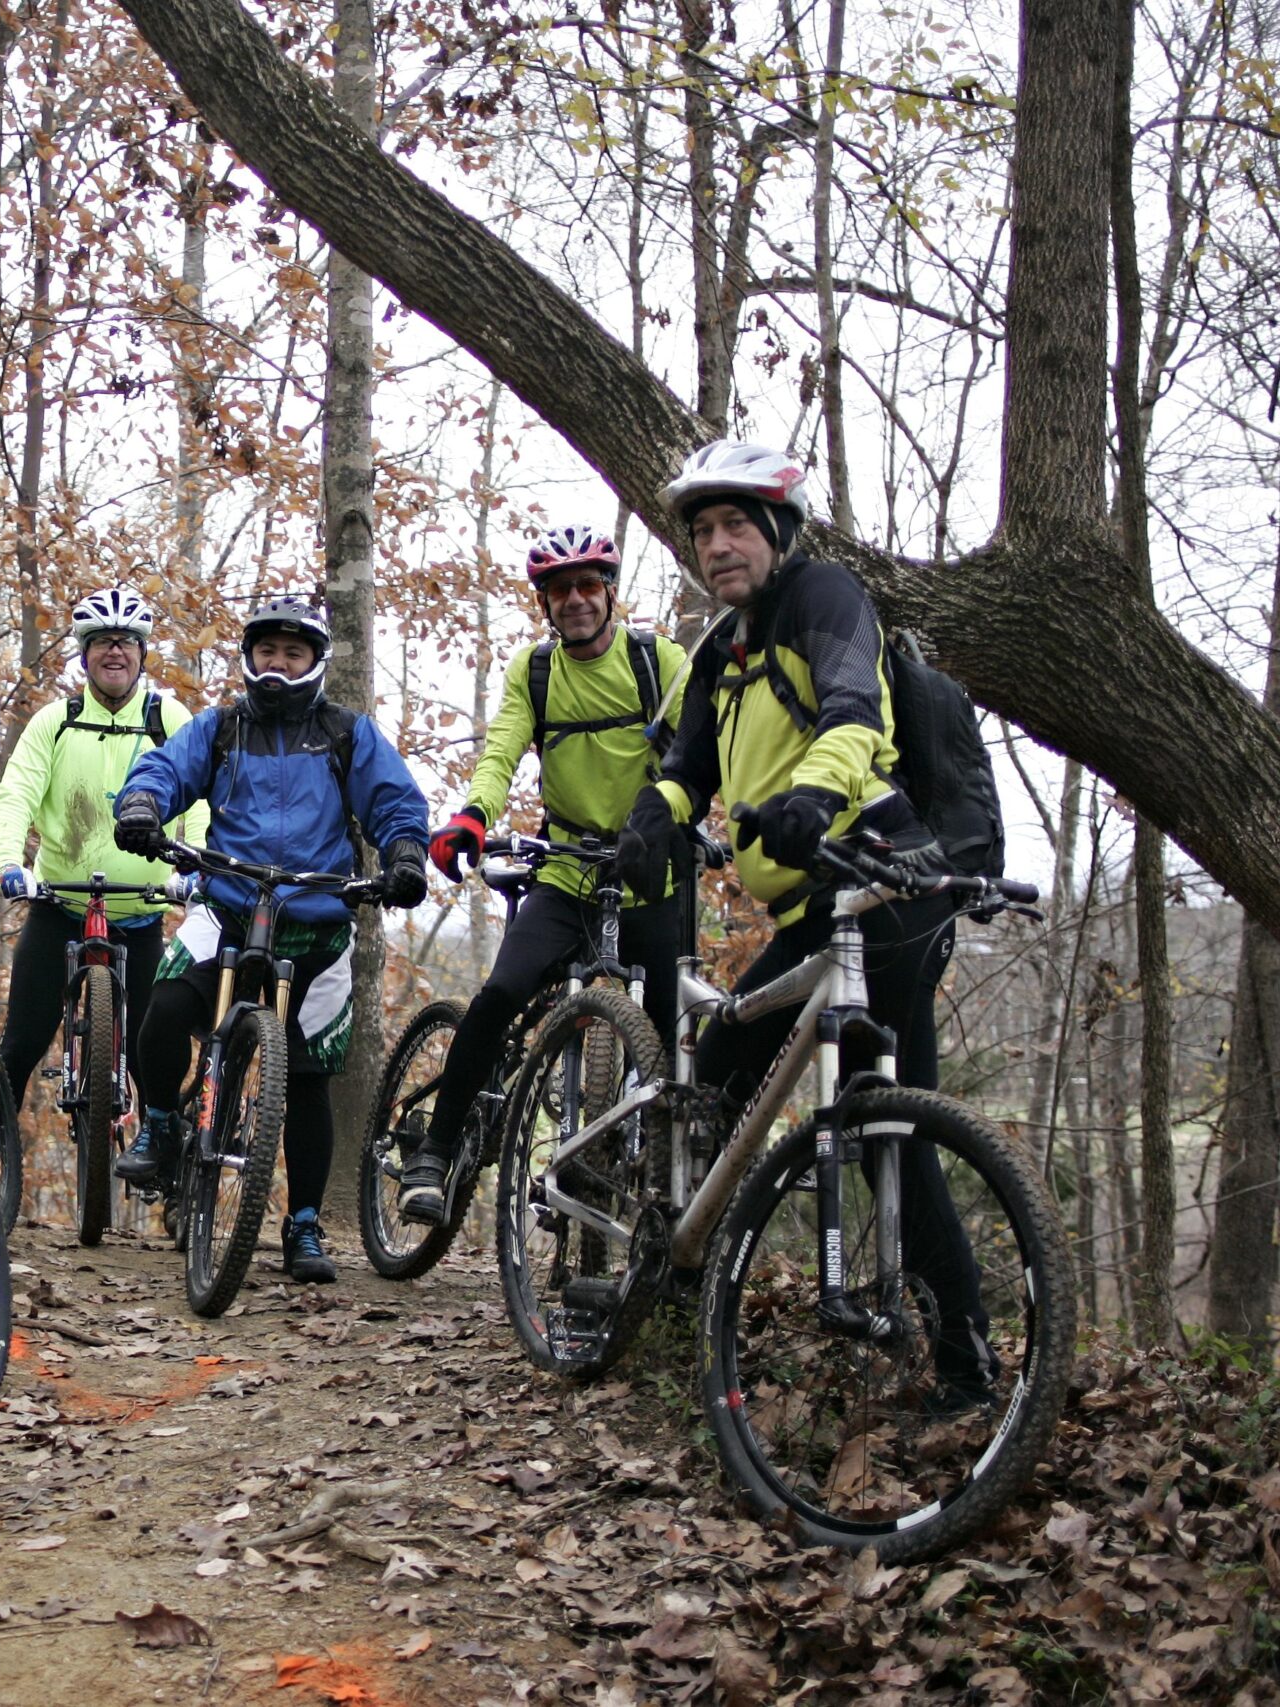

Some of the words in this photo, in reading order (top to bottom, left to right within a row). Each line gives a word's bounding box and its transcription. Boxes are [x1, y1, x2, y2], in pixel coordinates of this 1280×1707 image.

[509, 1053, 549, 1267] EASTON
[705, 1232, 734, 1336] FORTE
[730, 1229, 754, 1283] SRAM
[826, 1228, 842, 1287] ROCKSHOX
[1000, 1386, 1024, 1437] SRAM
